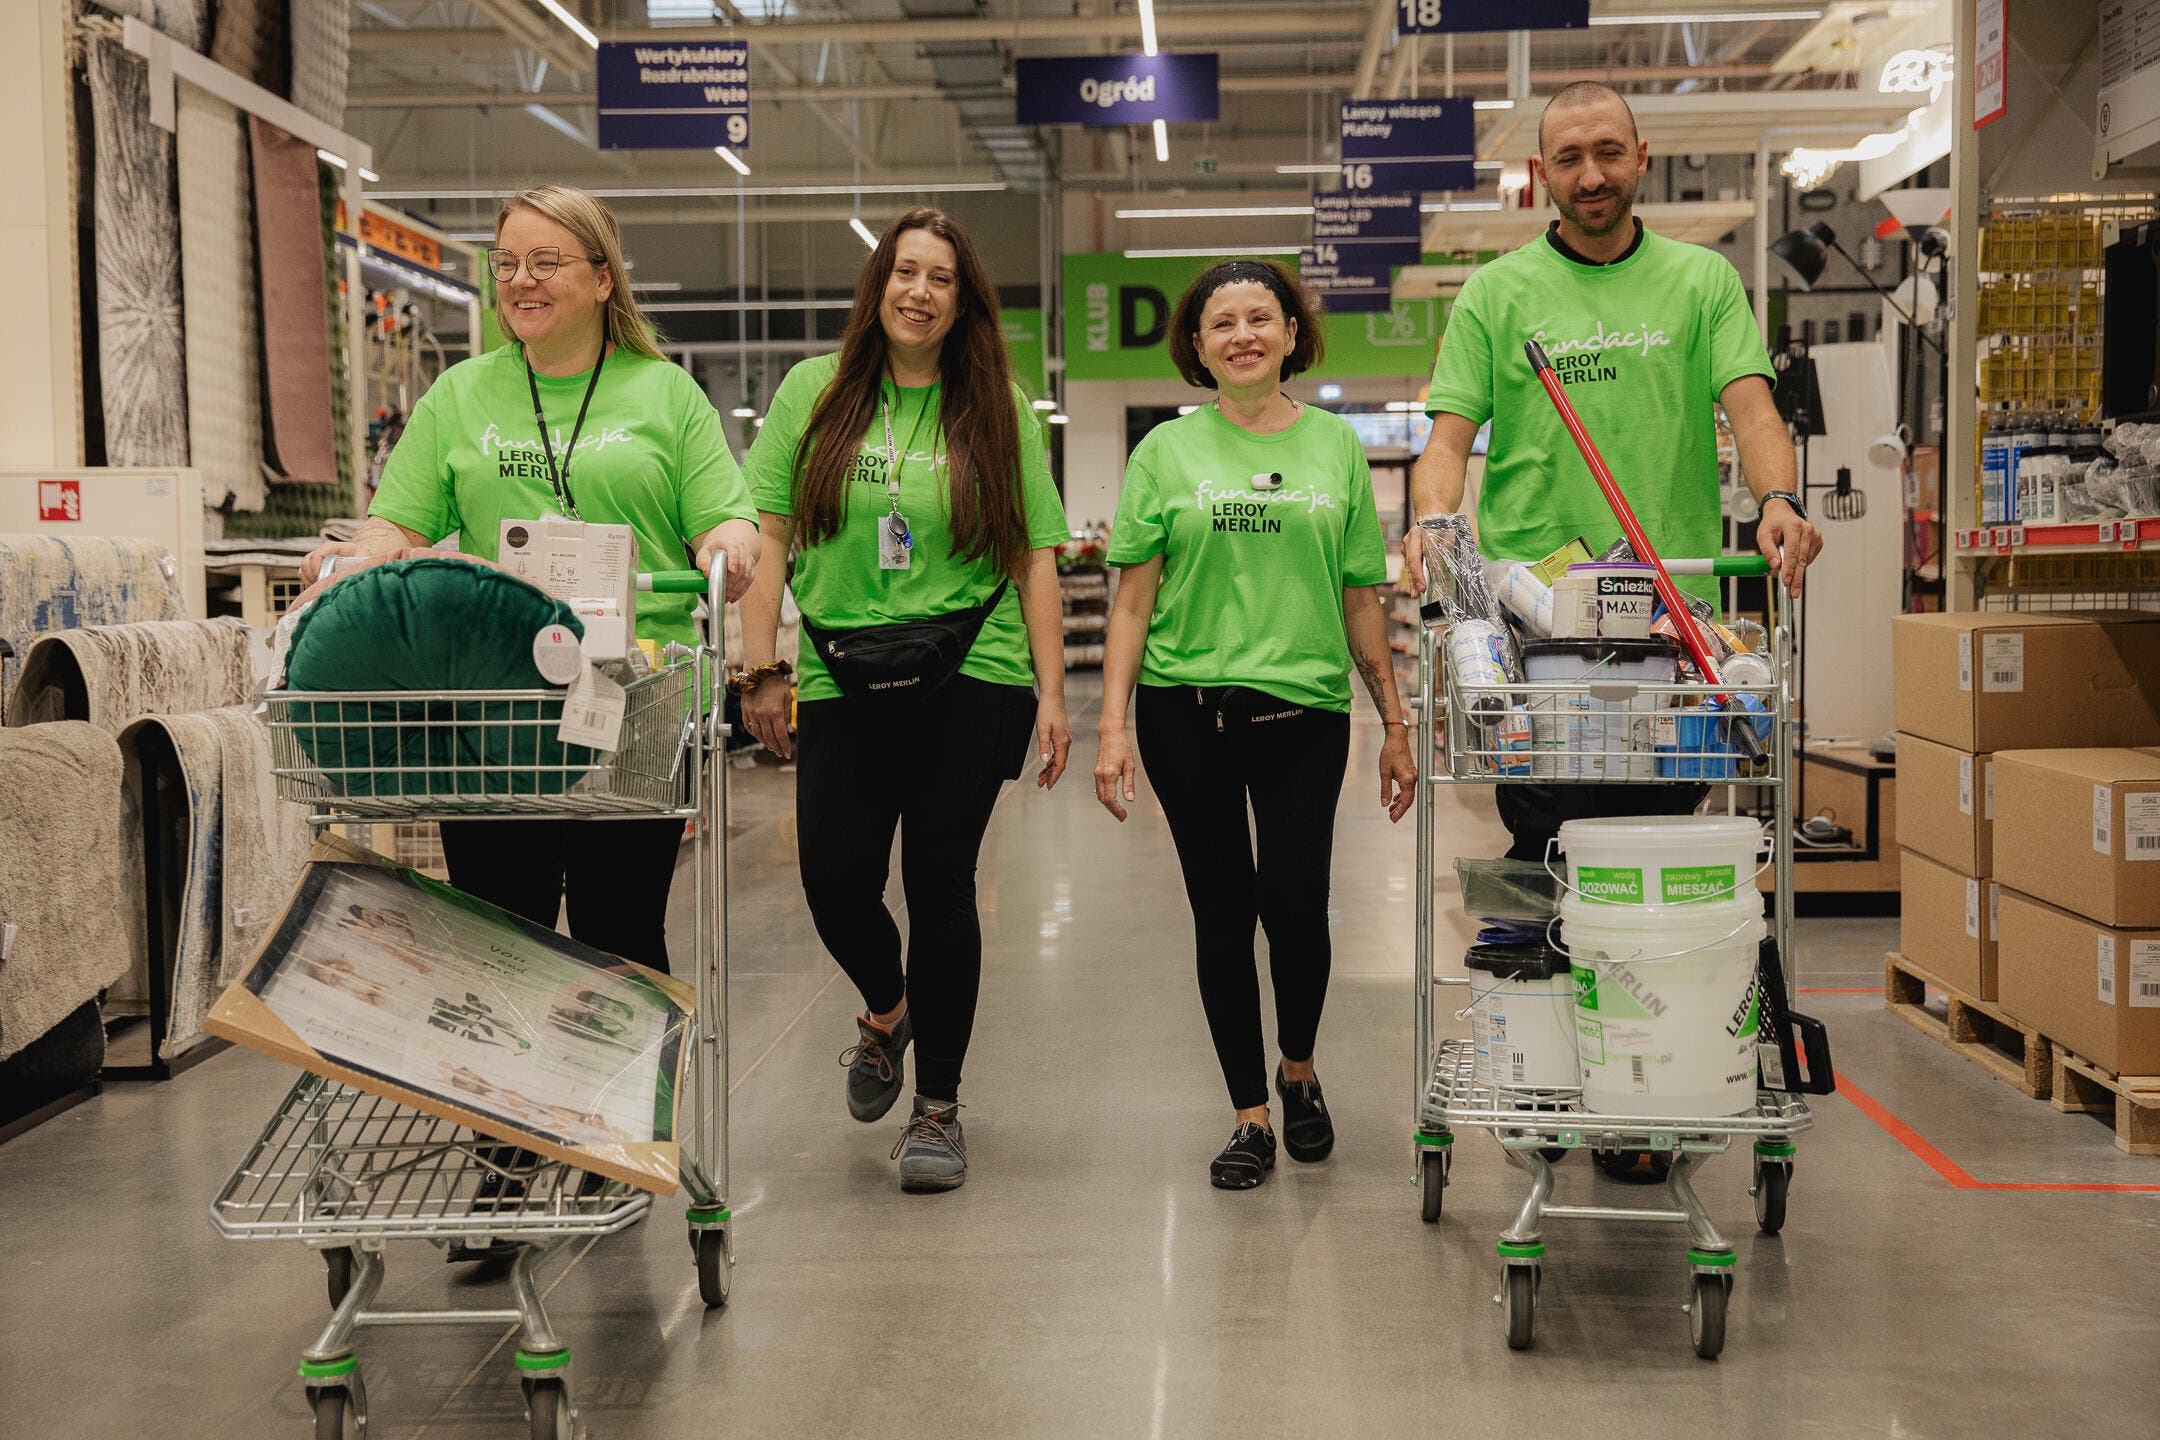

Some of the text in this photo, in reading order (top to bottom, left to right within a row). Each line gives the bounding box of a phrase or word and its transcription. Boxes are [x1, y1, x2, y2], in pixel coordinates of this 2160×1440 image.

[1401, 0, 1442, 27] 18
[634, 46, 747, 66] Wertykulatory
[640, 66, 747, 83] Rozdrabniacze
[704, 86, 747, 105] Węże
[1079, 74, 1155, 107] Ogród
[1342, 105, 1386, 122] Lampy
[727, 115, 747, 143] 9
[1342, 164, 1374, 190] 16
[1314, 244, 1339, 264] 14
[1086, 282, 1109, 352] KLUB
[1553, 352, 1601, 372] EROY
[1212, 502, 1268, 518] LEROY
[1212, 518, 1282, 534] MERLIN
[1607, 601, 1637, 614] MAX
[868, 675, 920, 690] LEROY MERLIN
[1251, 708, 1304, 723] LEROY MERLIN
[1581, 881, 1639, 896] DOZOWAĆ
[1666, 880, 1724, 896] MIESZAĆ
